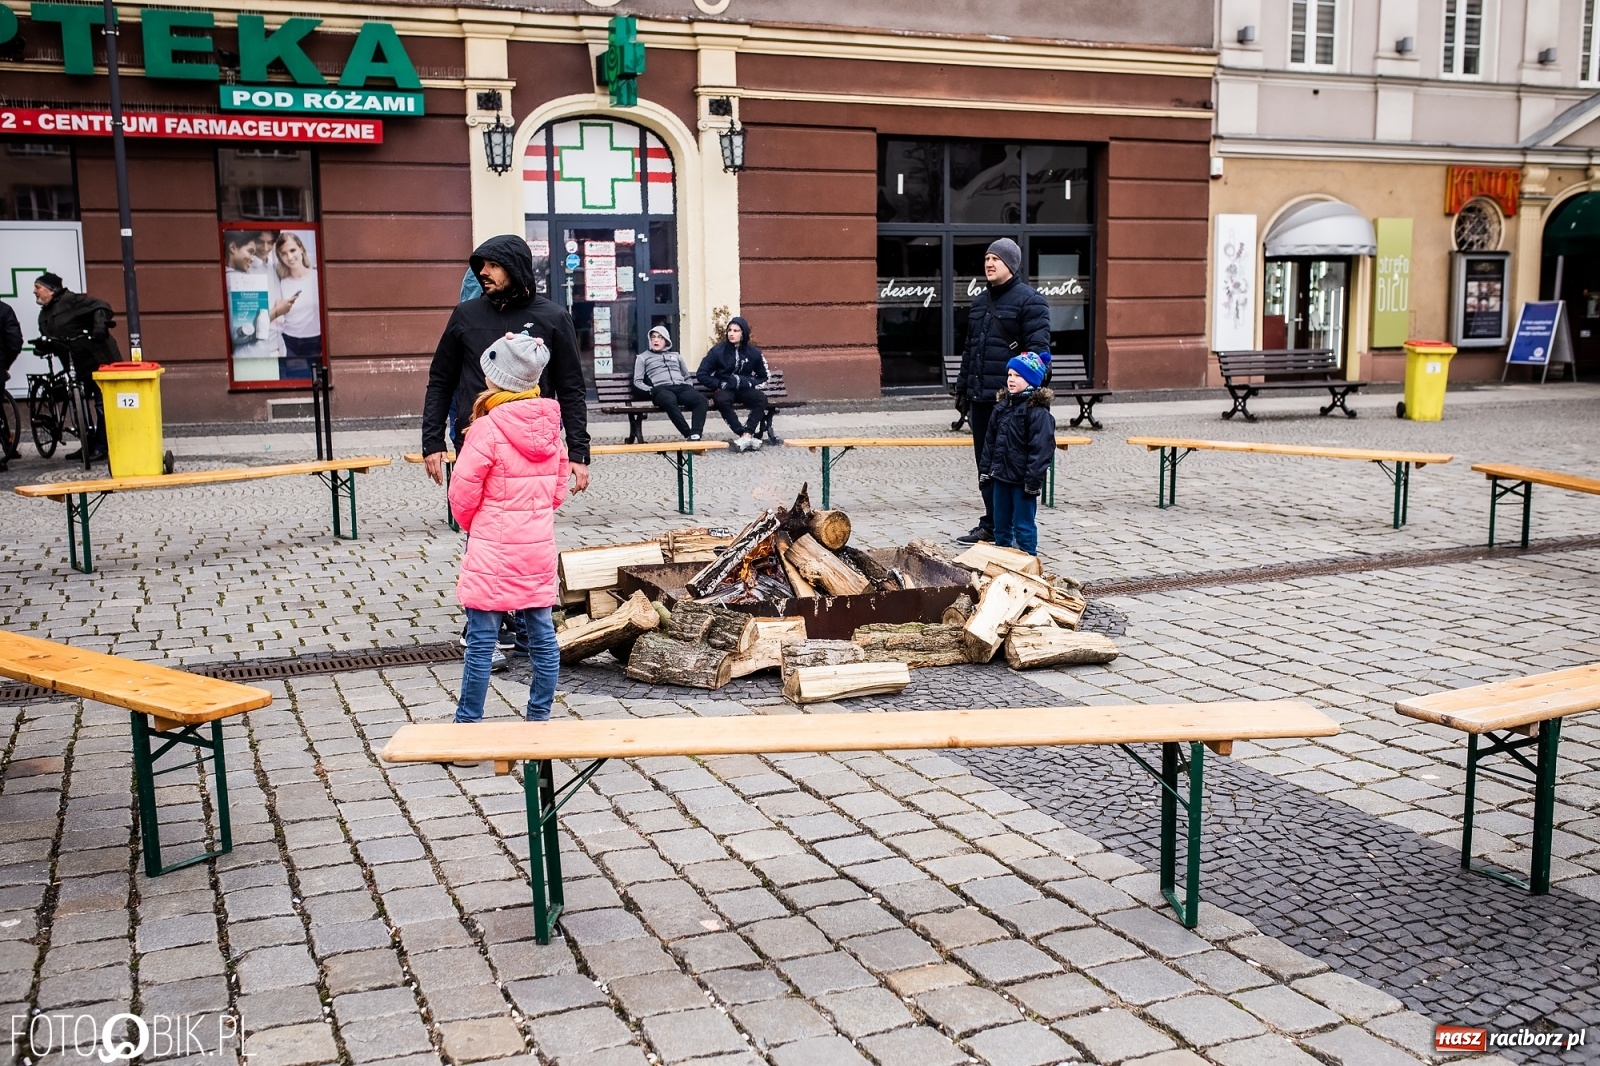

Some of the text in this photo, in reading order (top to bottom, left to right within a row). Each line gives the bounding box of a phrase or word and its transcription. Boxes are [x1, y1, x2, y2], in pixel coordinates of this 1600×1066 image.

[0, 3, 423, 88] TEKA
[232, 90, 415, 112] POD RÓŻAMI
[1, 112, 16, 129] 2
[165, 118, 375, 139] FARMACEUTYCZNE
[1452, 169, 1520, 207] KANTOR
[1378, 254, 1409, 274] strefa
[880, 278, 937, 308] desery
[122, 398, 134, 407] 12
